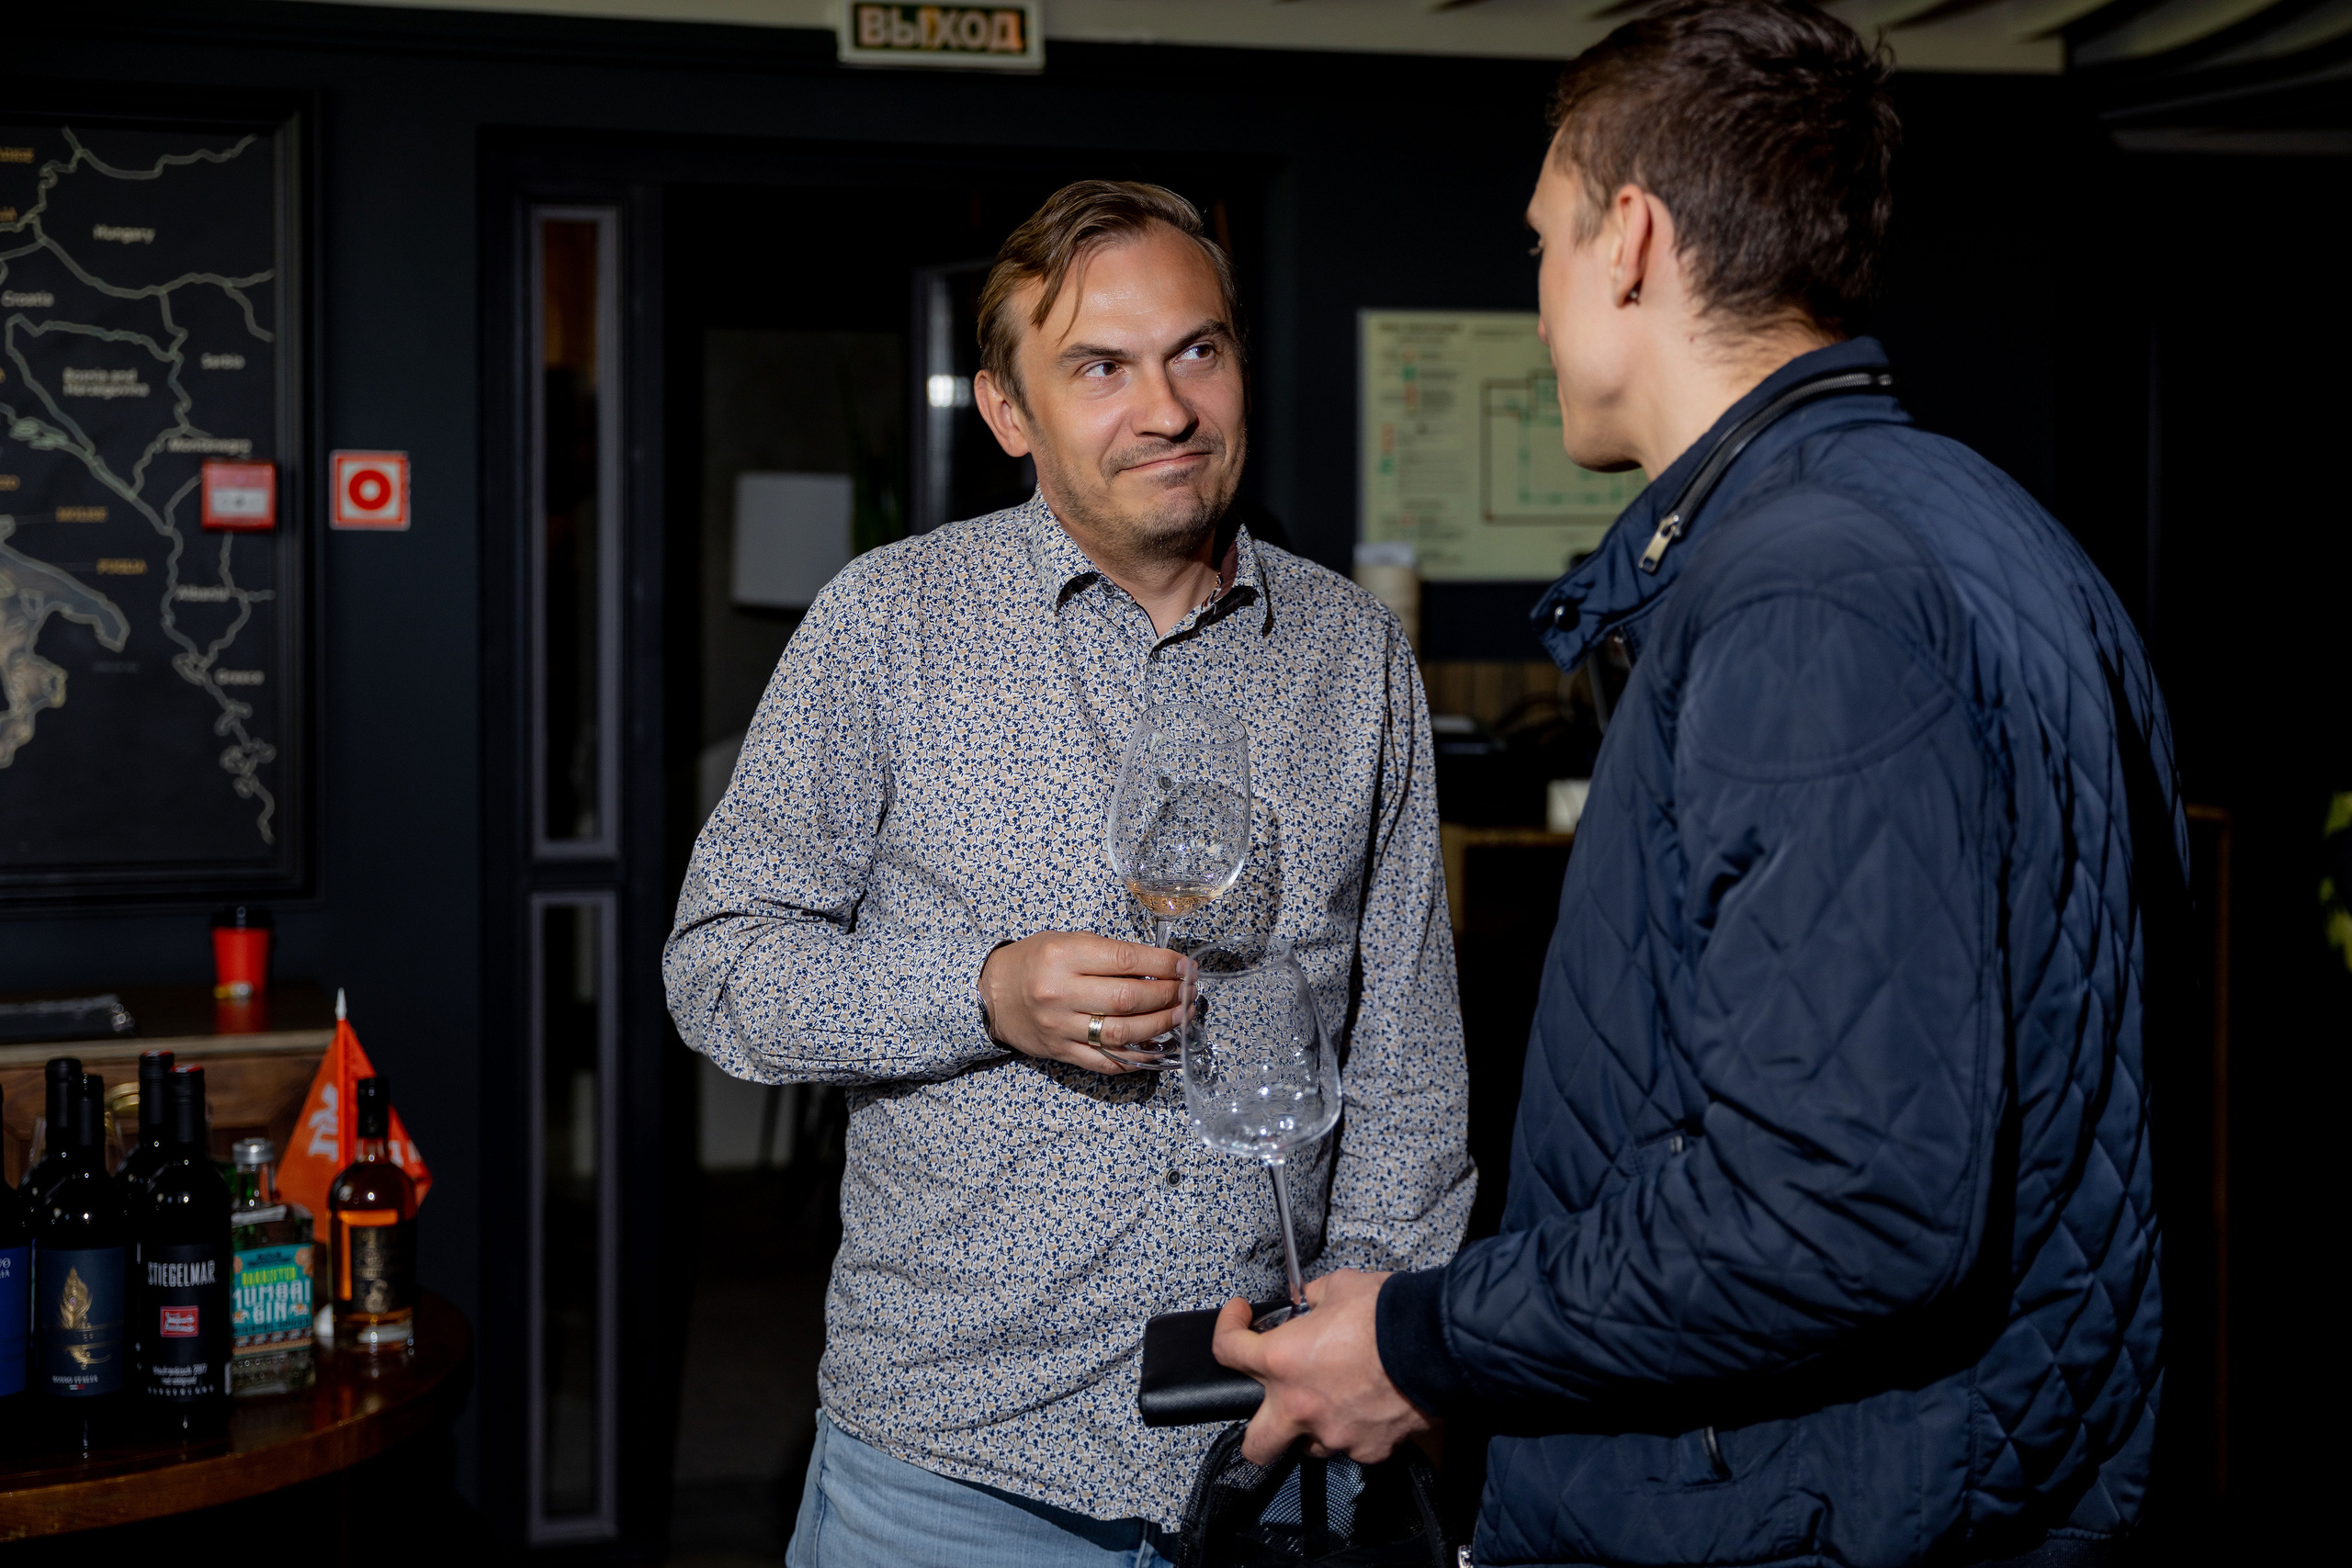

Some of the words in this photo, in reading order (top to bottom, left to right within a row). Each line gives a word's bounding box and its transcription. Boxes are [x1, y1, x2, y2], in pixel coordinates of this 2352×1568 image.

[859, 6, 1023, 51] ВЫХОД
[93, 224, 155, 244] Hungary
[1, 289, 55, 308] Croatia
[200, 352, 245, 370] Serbia
[148, 1259, 216, 1287] STIEGELMAR
[253, 1300, 288, 1325] GIN
